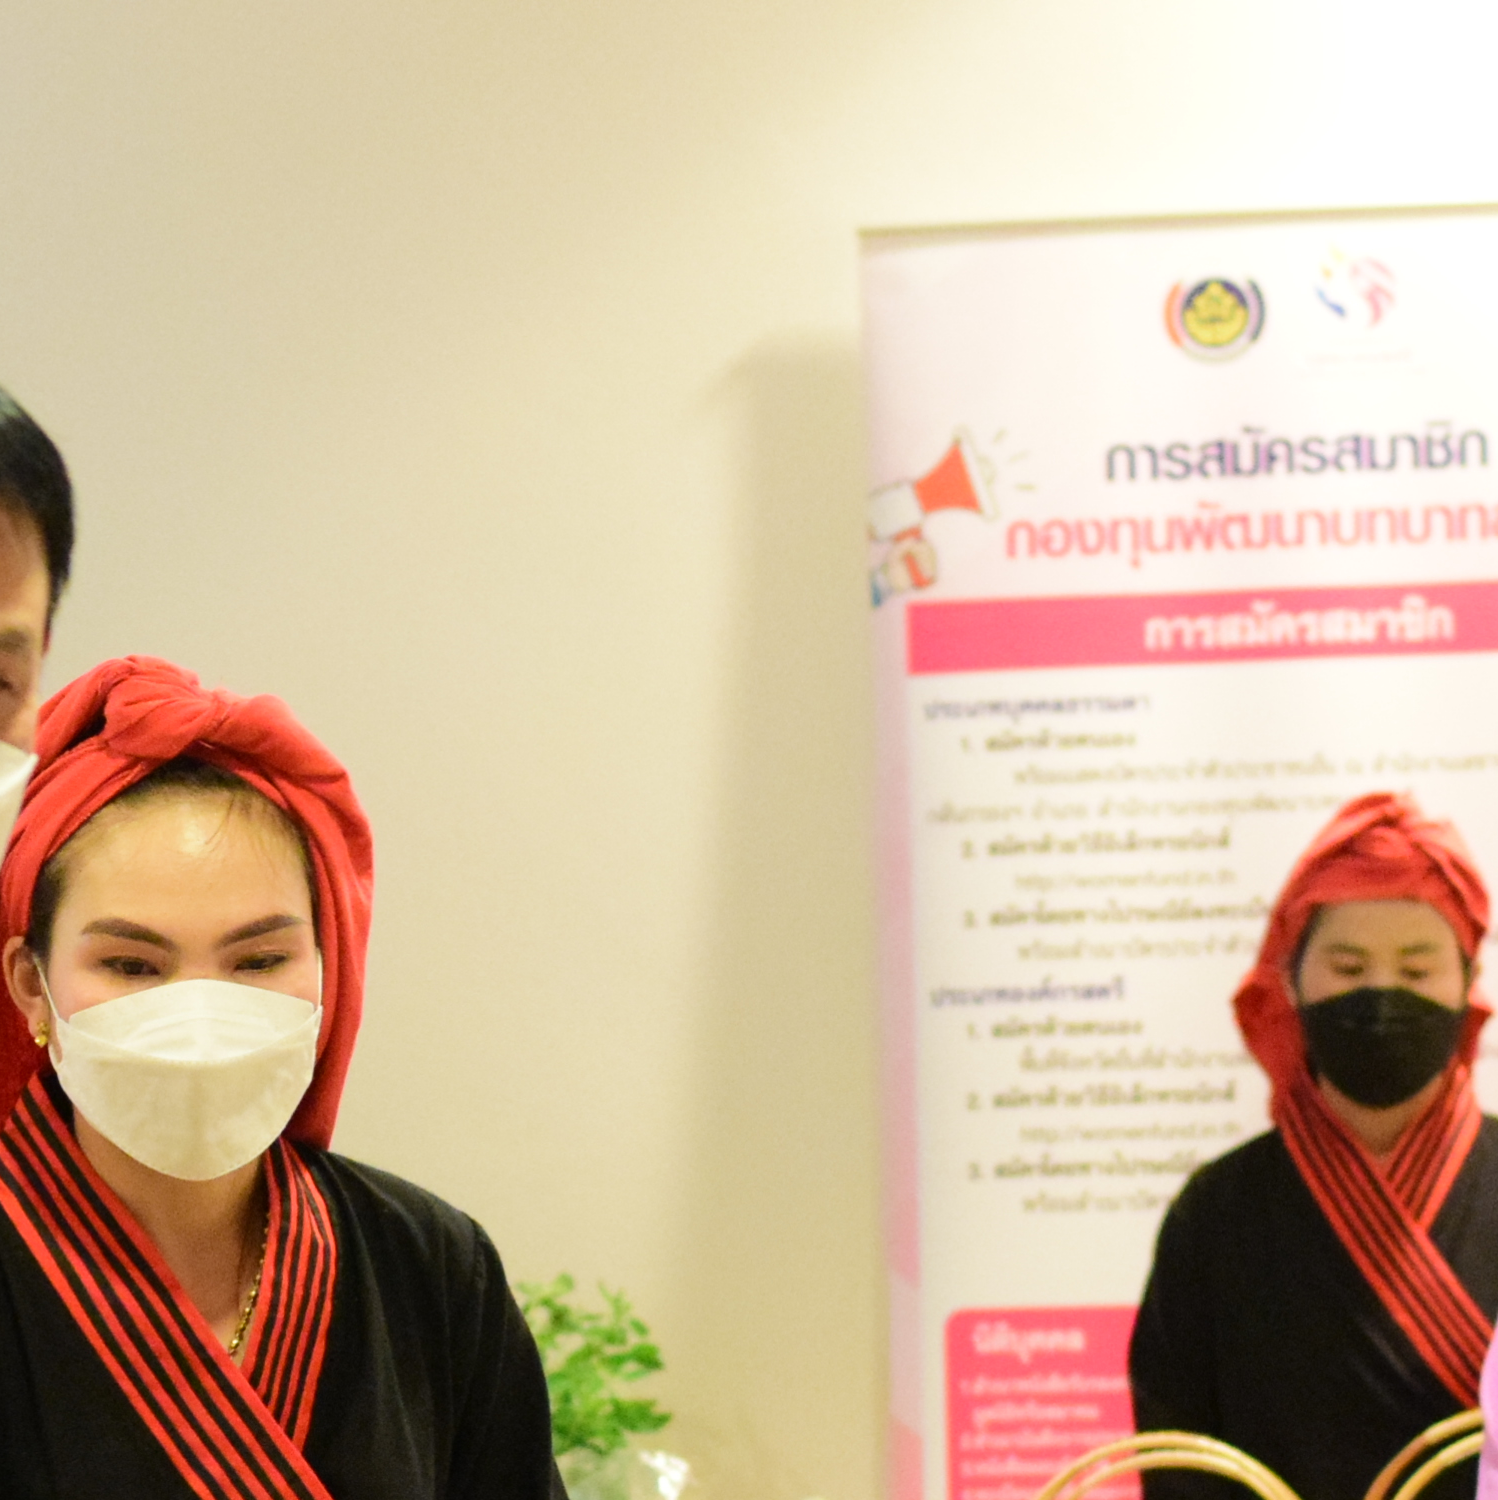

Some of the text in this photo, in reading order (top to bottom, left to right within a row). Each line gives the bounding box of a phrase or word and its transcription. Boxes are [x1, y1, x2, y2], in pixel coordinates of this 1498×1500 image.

[1105, 420, 1490, 483] การสมัครสมาชิก
[1144, 594, 1455, 654] การสมัครสมาชิก
